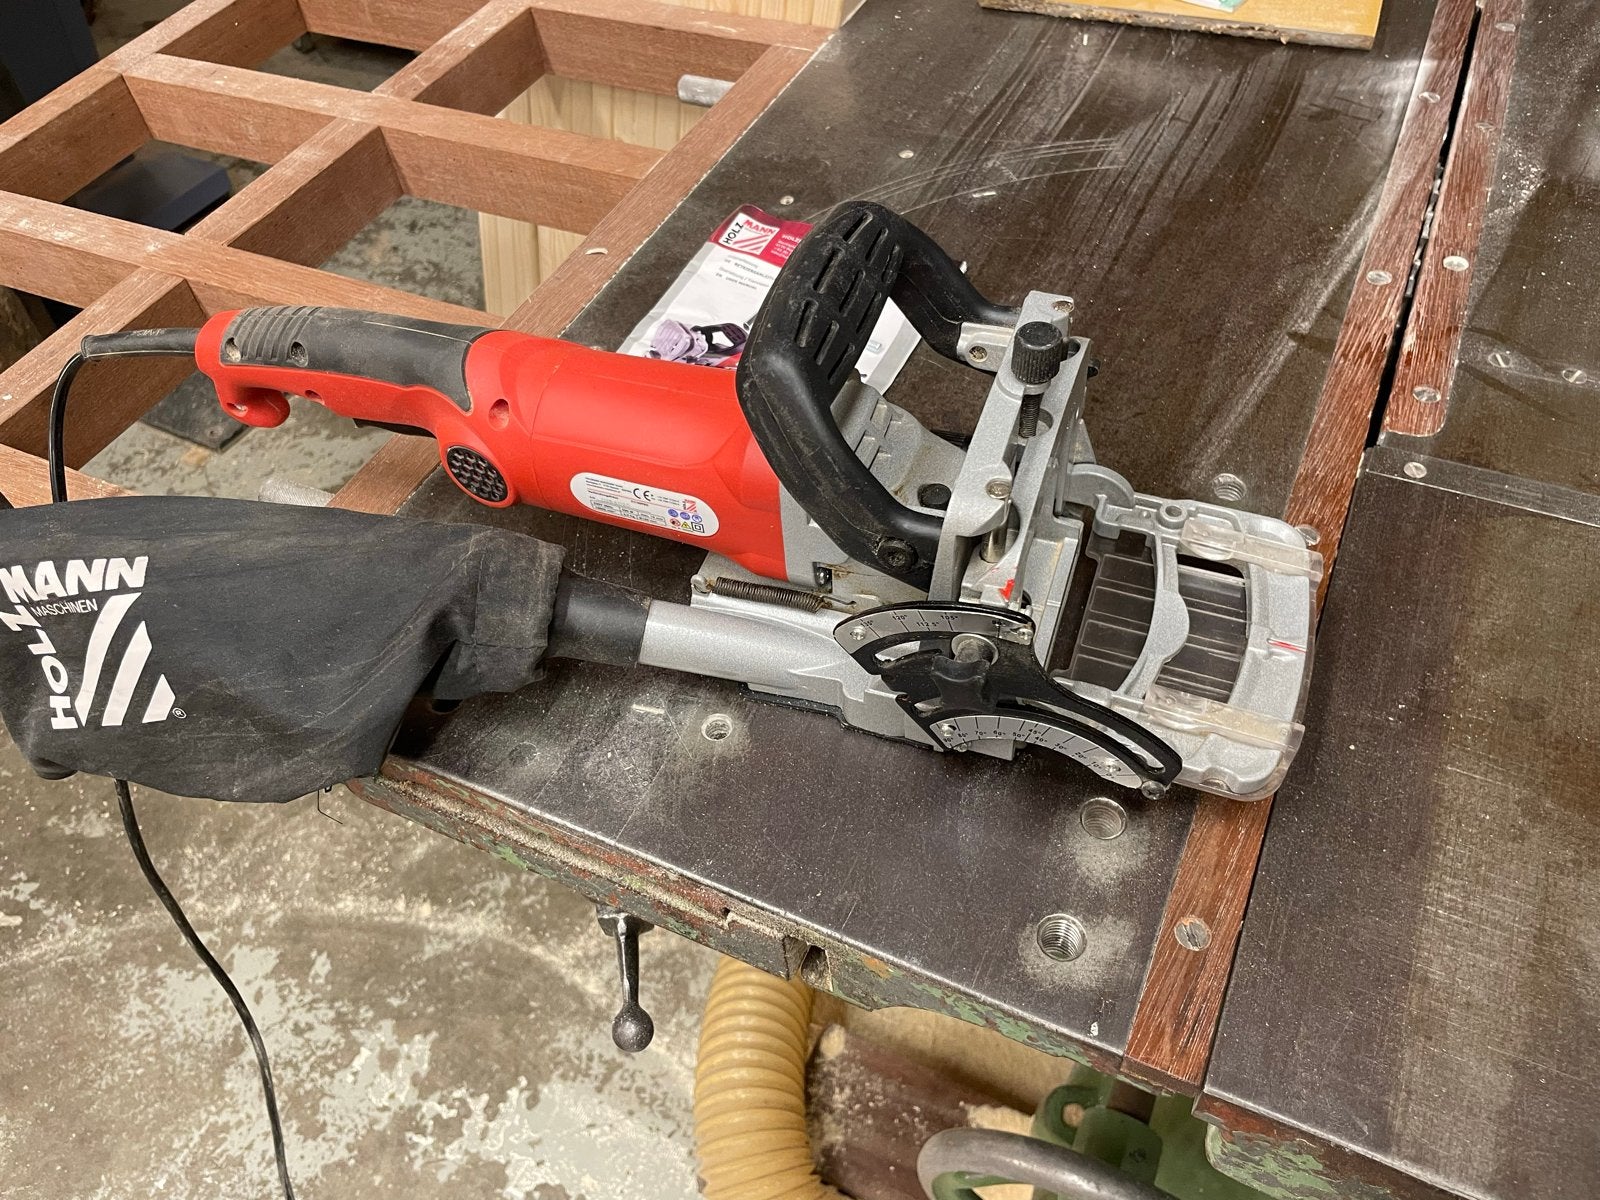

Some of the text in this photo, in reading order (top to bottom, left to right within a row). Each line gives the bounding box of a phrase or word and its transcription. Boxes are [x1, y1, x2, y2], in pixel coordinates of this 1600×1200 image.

[723, 221, 744, 244] HOLZ
[743, 219, 776, 234] MANN
[0, 556, 149, 604] MANN
[31, 598, 99, 618] MASCHINEN
[0, 604, 79, 730] HOLZ
